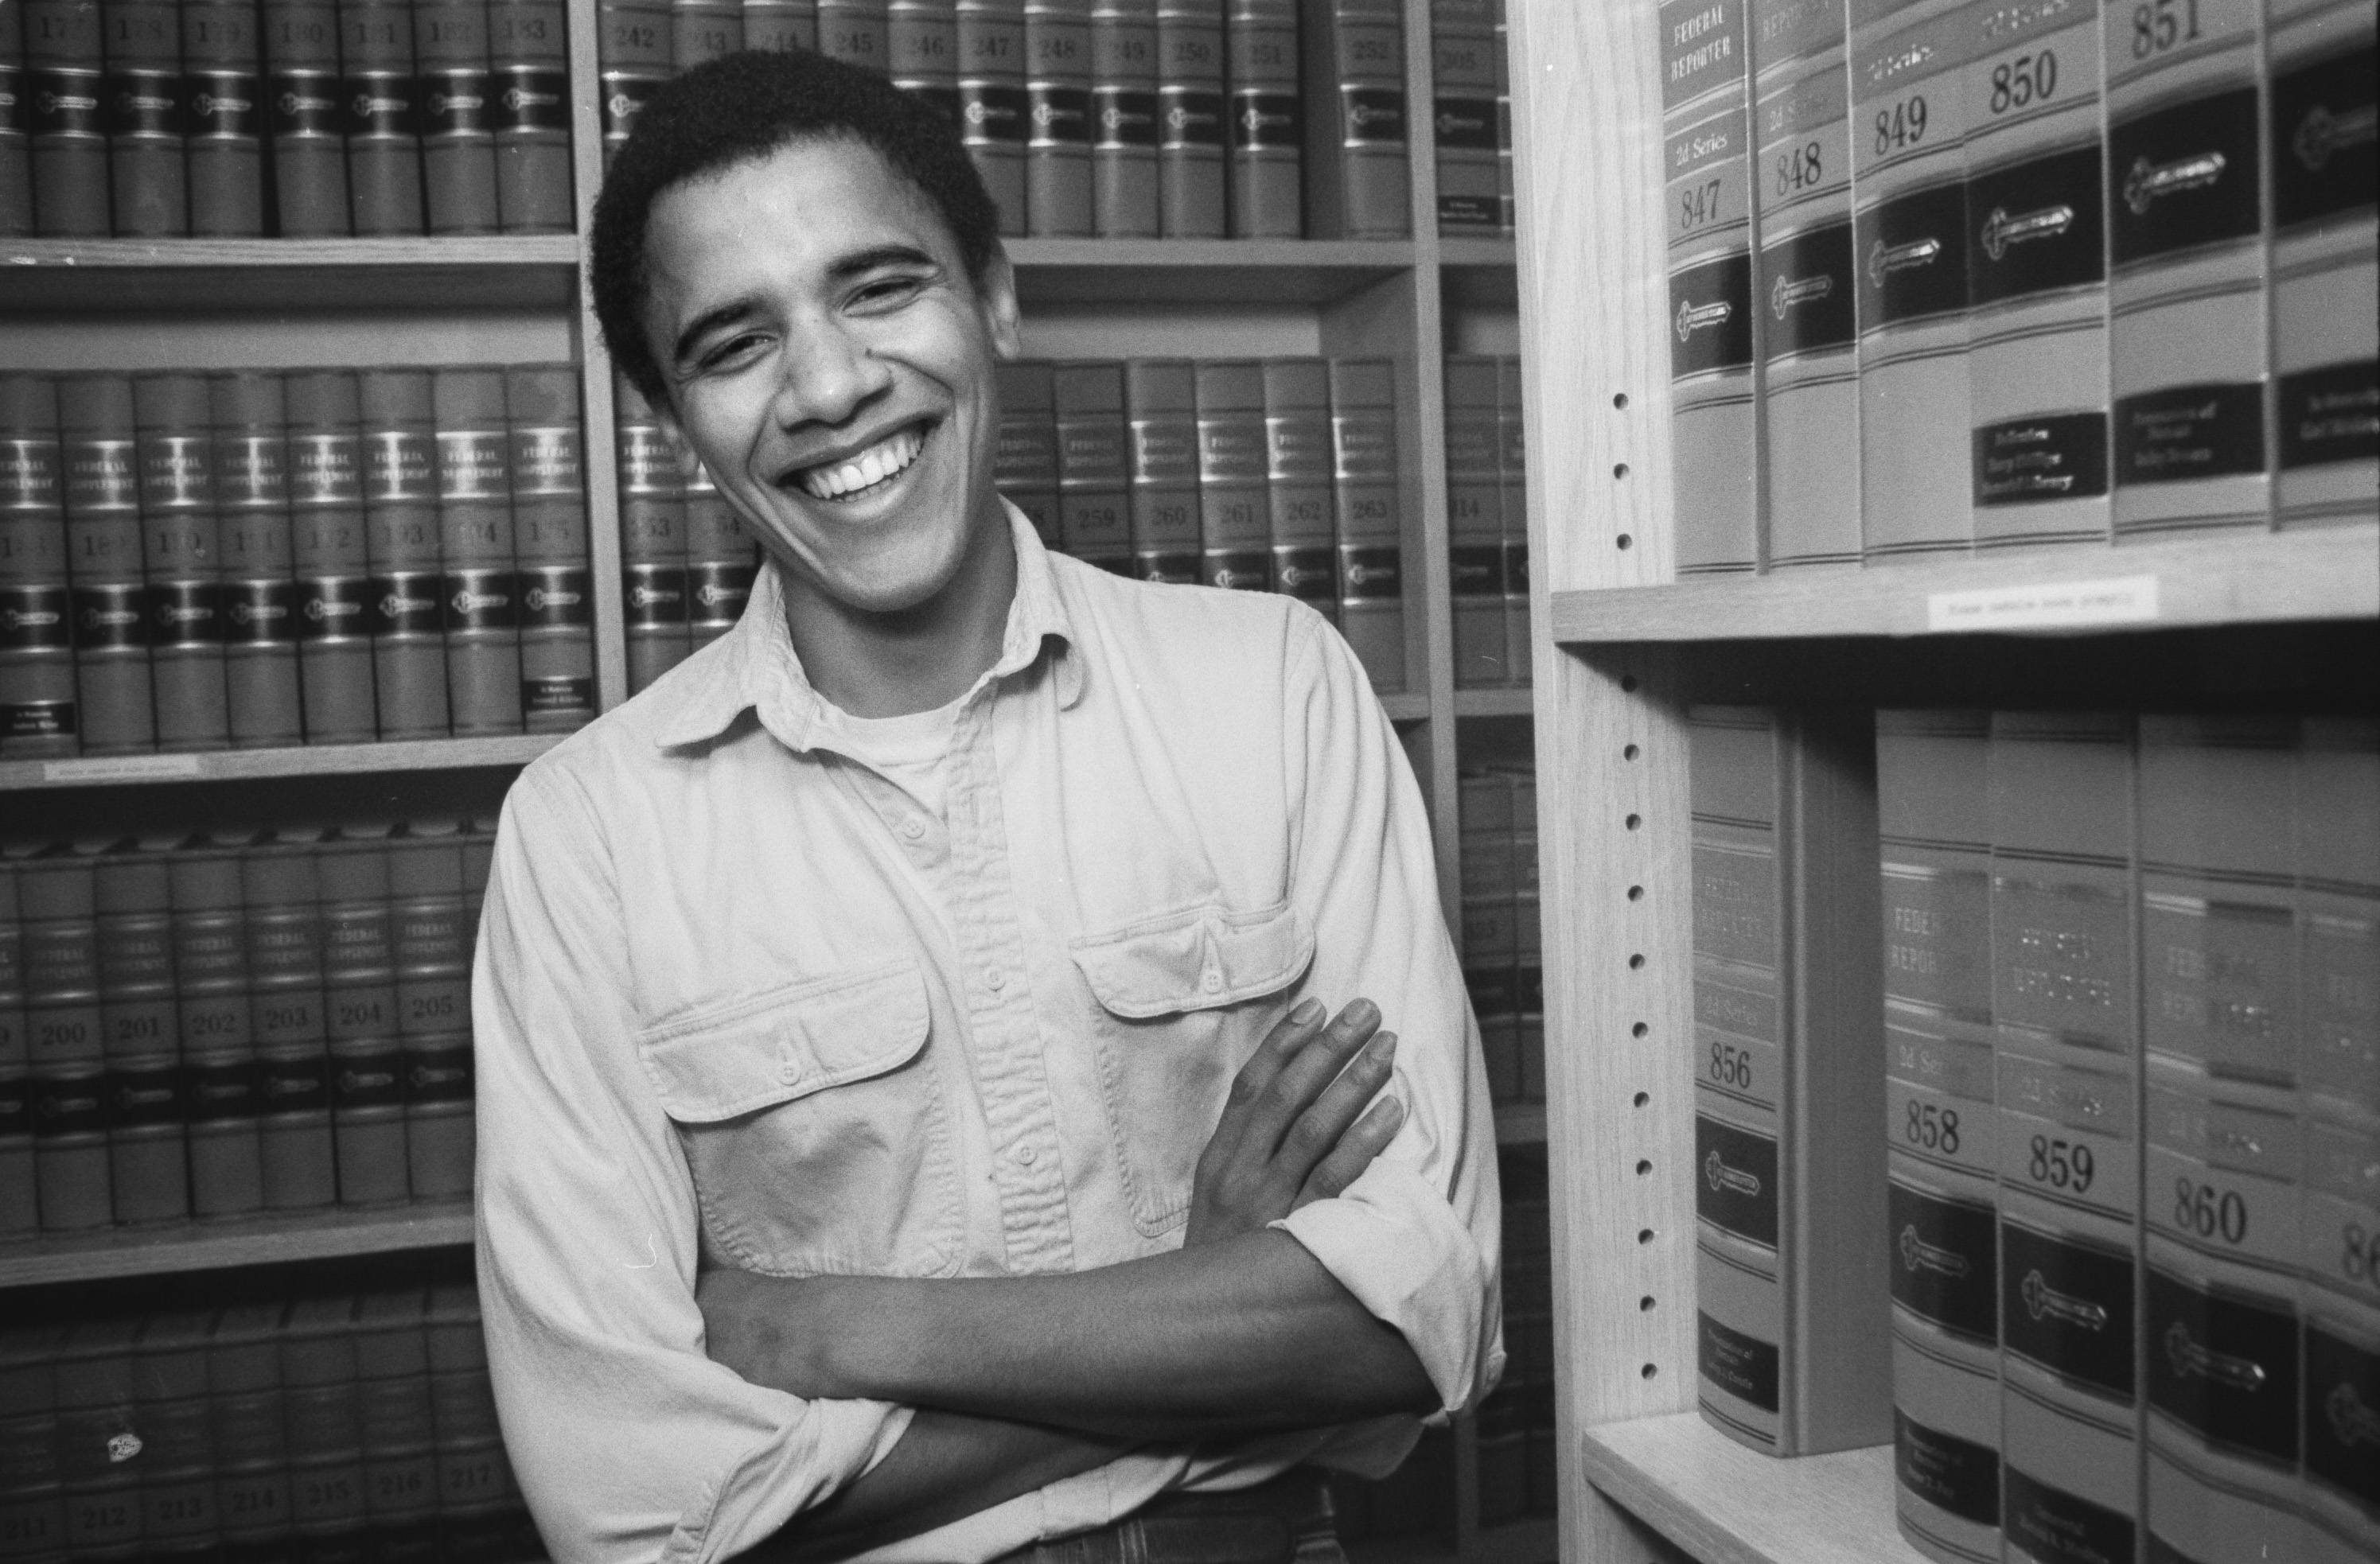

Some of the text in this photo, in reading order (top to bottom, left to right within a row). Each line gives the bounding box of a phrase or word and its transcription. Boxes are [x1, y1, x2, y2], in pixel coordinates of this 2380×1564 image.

[1674, 4, 1725, 47] FEDERAL
[2132, 0, 2199, 60] 851
[1671, 35, 1731, 83] REPORTER
[1990, 49, 2057, 115] 850
[1876, 95, 1927, 156] 849
[1676, 134, 1728, 166] 2d Series
[1776, 142, 1821, 196] 848
[1681, 179, 1721, 229] 847
[1077, 507, 1116, 529] 259
[1287, 501, 1321, 522] 262
[1353, 500, 1388, 520] 263
[265, 1006, 309, 1030] 203
[340, 1003, 381, 1026] 204
[412, 996, 454, 1020] 205
[41, 1023, 86, 1047] 200
[118, 1016, 161, 1041] 201
[191, 1013, 236, 1036] 202
[1712, 1042, 1751, 1089] 856
[1907, 1099, 1960, 1155] 858
[2030, 1134, 2094, 1193] 859
[2175, 1176, 2249, 1245] 860
[307, 1480, 351, 1505] 215
[379, 1472, 423, 1496] 216
[158, 1497, 202, 1521] 213
[232, 1488, 275, 1512] 214
[6, 1516, 47, 1541] 211
[82, 1505, 127, 1530] 212
